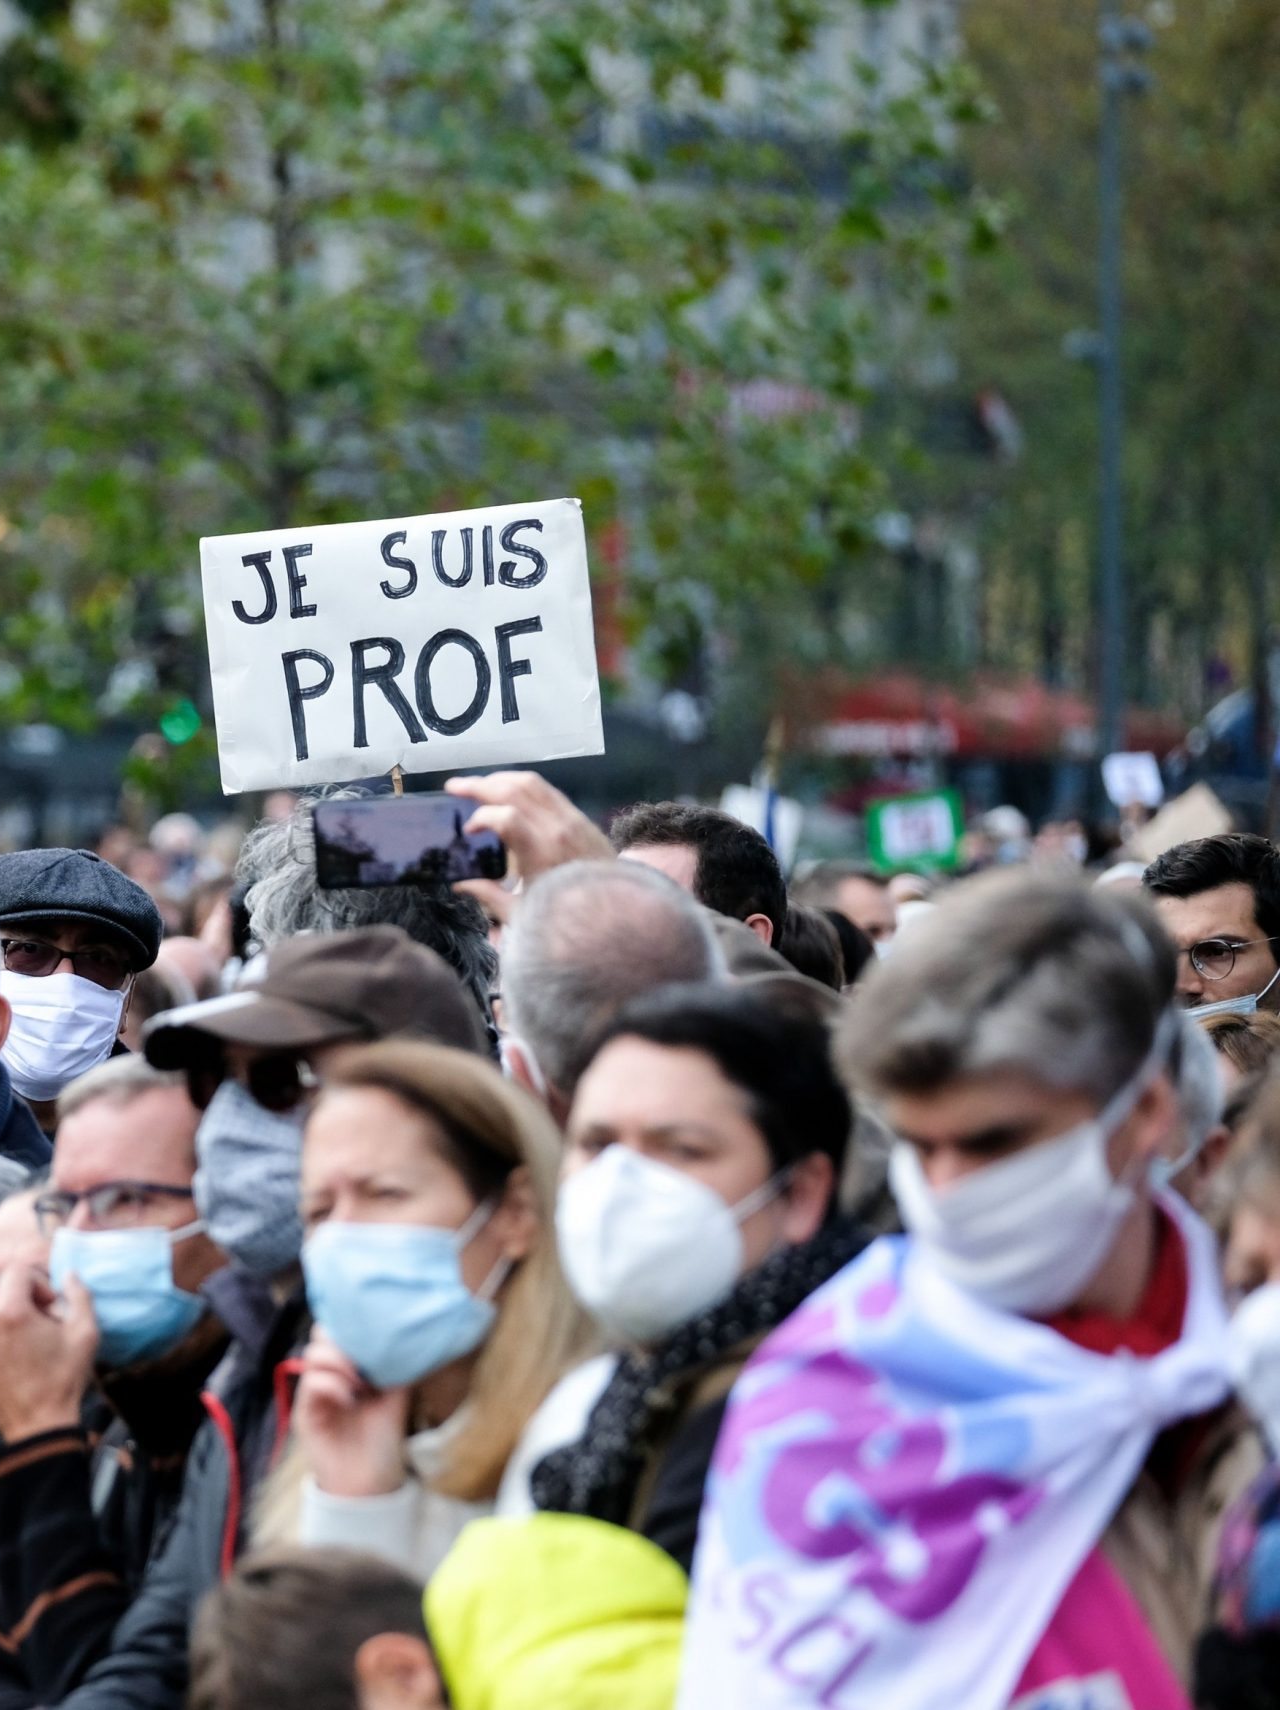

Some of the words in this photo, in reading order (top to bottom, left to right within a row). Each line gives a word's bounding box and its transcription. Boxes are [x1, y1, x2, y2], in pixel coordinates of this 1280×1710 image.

[231, 543, 318, 625] JE
[379, 518, 549, 600] SUIS
[281, 615, 544, 762] PROF
